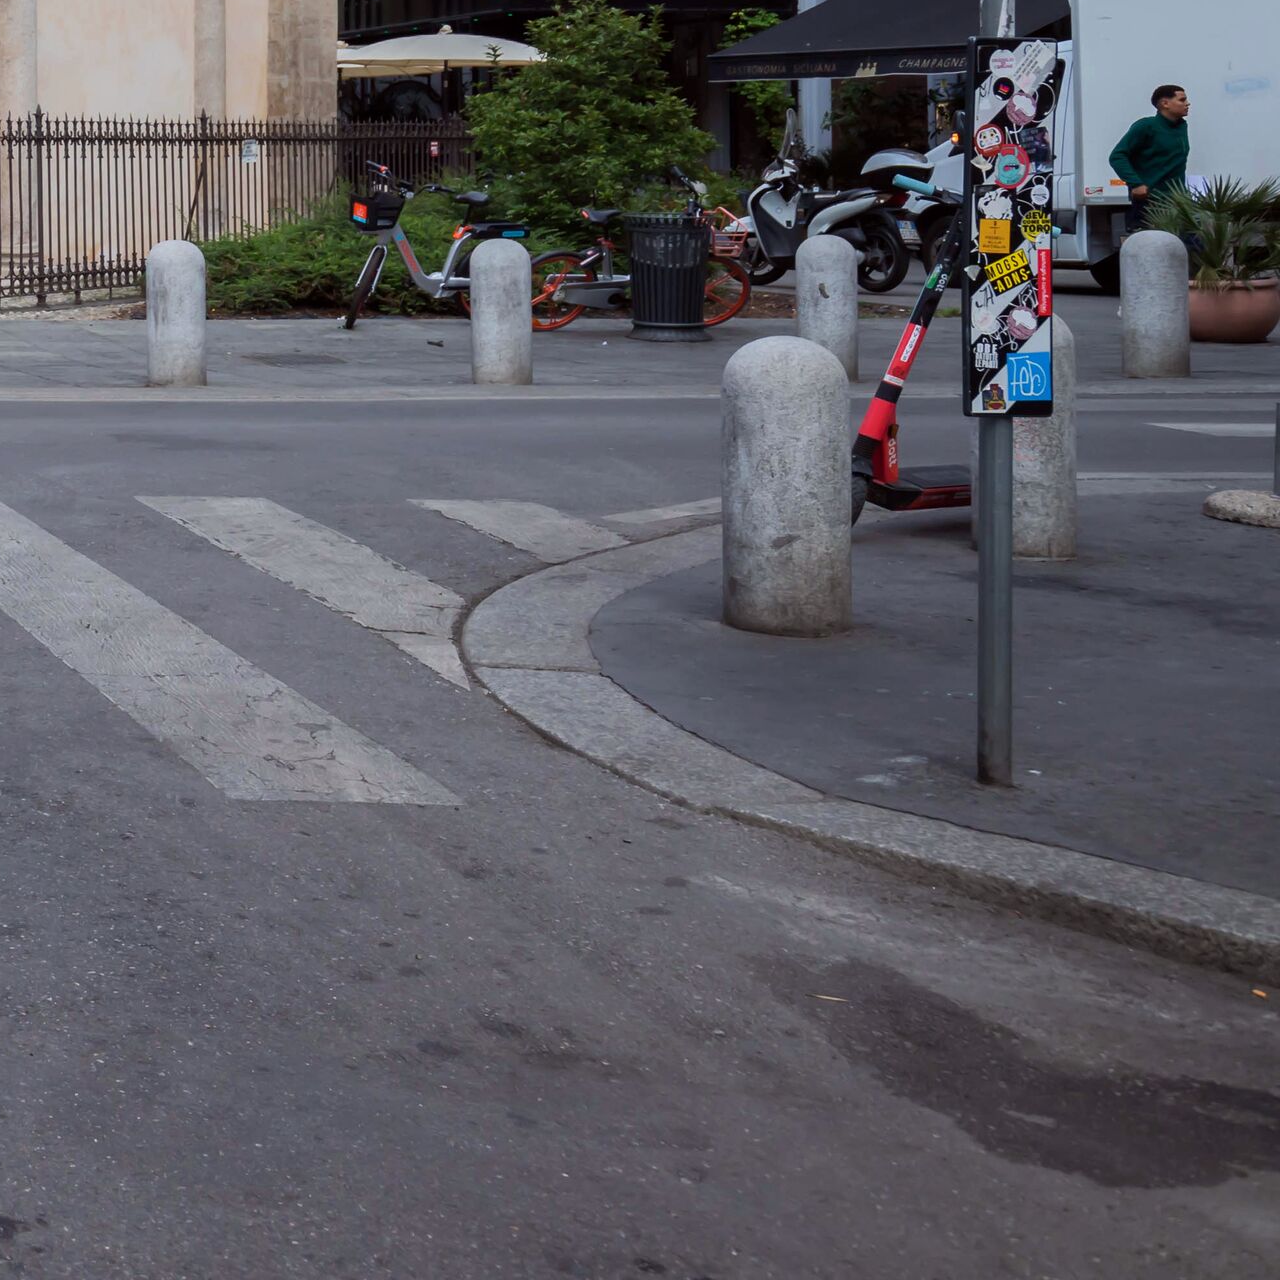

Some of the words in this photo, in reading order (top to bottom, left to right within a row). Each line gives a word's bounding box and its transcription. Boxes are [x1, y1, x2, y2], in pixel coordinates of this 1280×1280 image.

[898, 57, 967, 68] CHAMPAGNE
[1025, 212, 1048, 220] BEVI
[1022, 224, 1051, 234] TORO
[985, 251, 1027, 279] MOGSY
[934, 273, 948, 291] dott
[888, 438, 897, 468] dott
